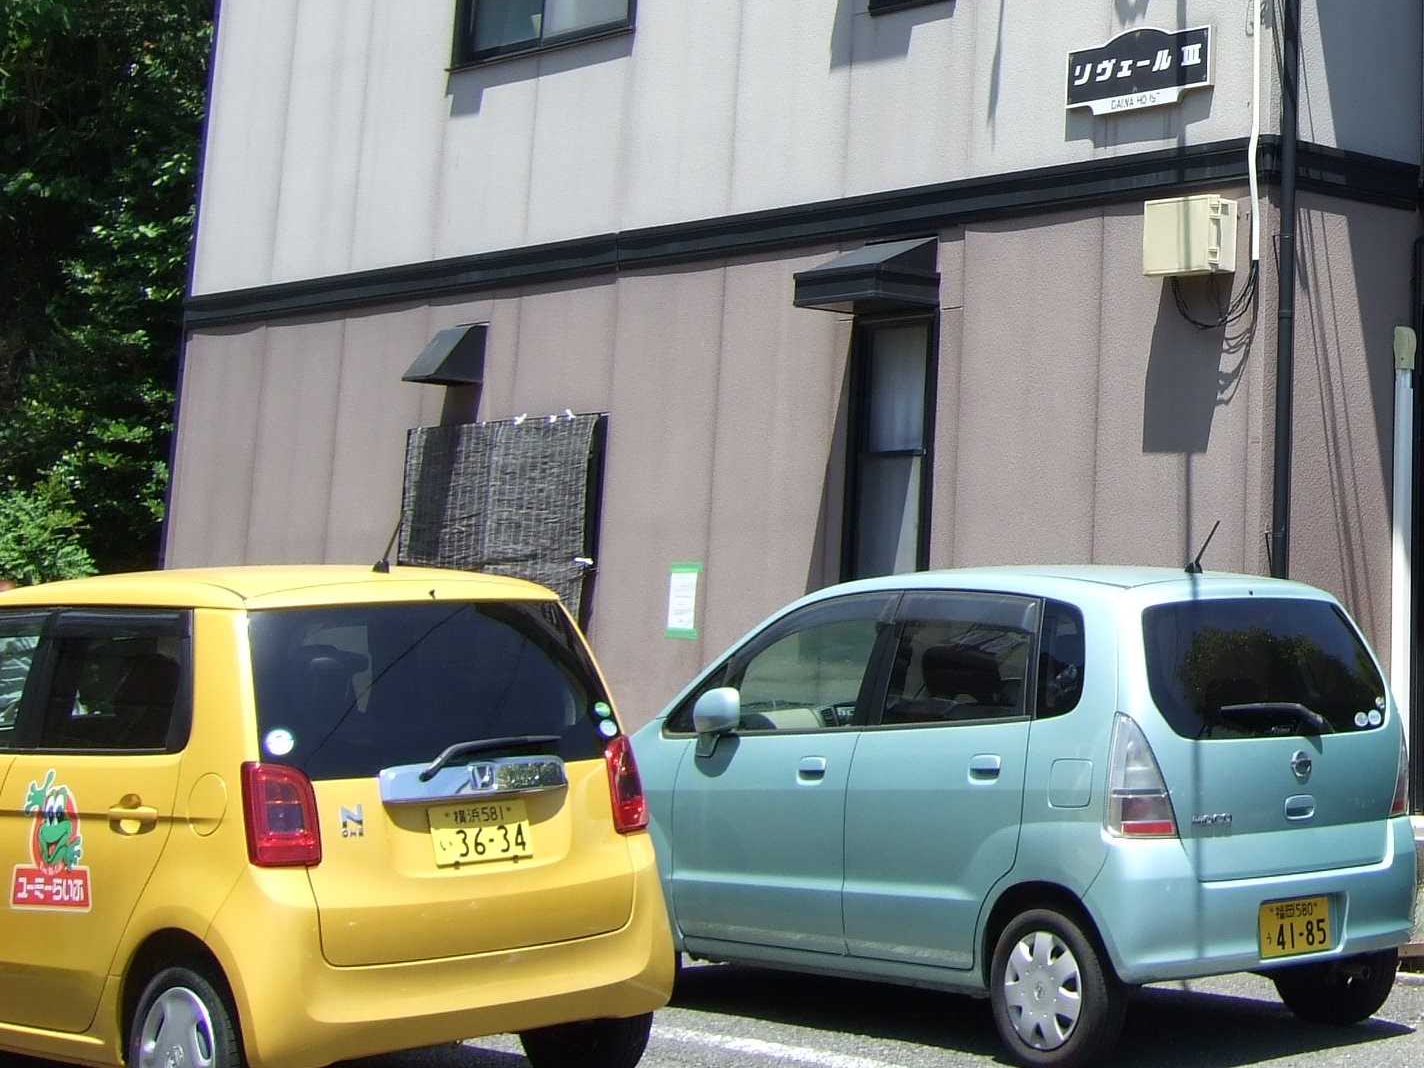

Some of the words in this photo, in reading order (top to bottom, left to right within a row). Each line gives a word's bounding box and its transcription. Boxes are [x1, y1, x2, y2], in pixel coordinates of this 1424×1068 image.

[439, 839, 453, 852] い
[456, 823, 526, 858] 36-34
[16, 876, 85, 902] ユーミーらいふ
[1276, 918, 1327, 950] 41-85
